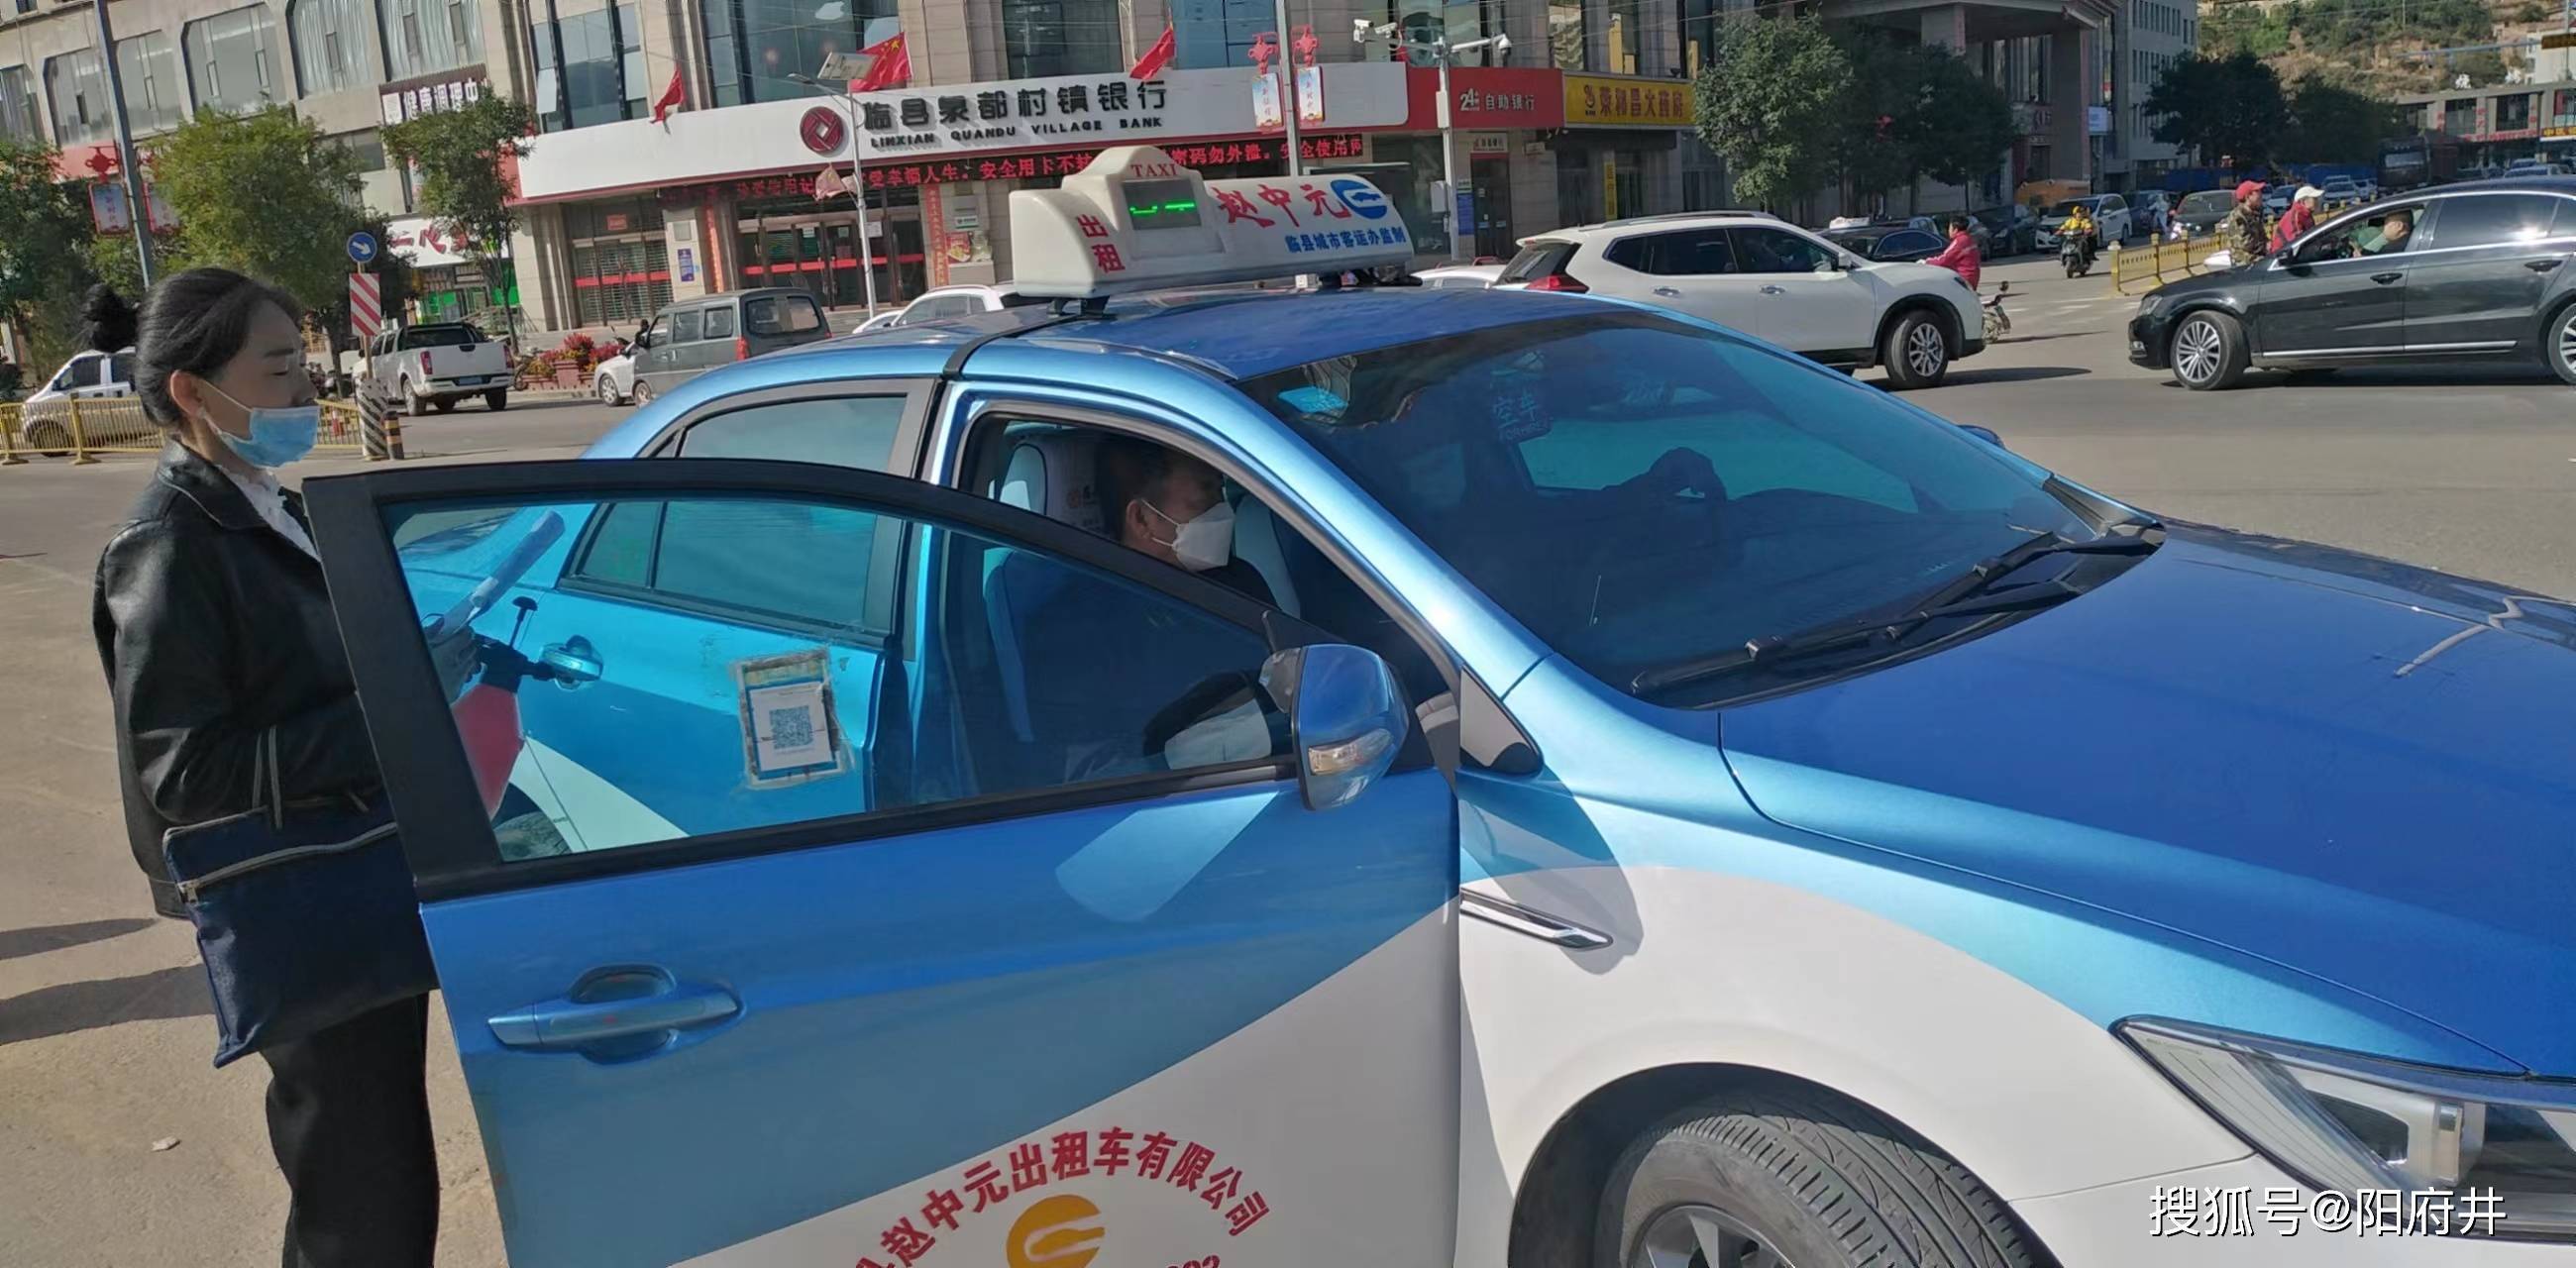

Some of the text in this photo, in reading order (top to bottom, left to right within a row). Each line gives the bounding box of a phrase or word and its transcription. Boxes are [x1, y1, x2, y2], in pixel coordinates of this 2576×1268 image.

[402, 77, 487, 121] 健康调理中
[862, 80, 1166, 130] 临县泉都村镇银行
[1486, 92, 1535, 111] 自助银行
[871, 116, 1162, 148] LINXIAN QUANDU VILLAGE BANK
[1131, 162, 1177, 177] TAXI
[1212, 183, 1352, 229] 赵中元
[1077, 214, 1126, 273] 出租
[1285, 226, 1407, 253] 临县城市客运办监制
